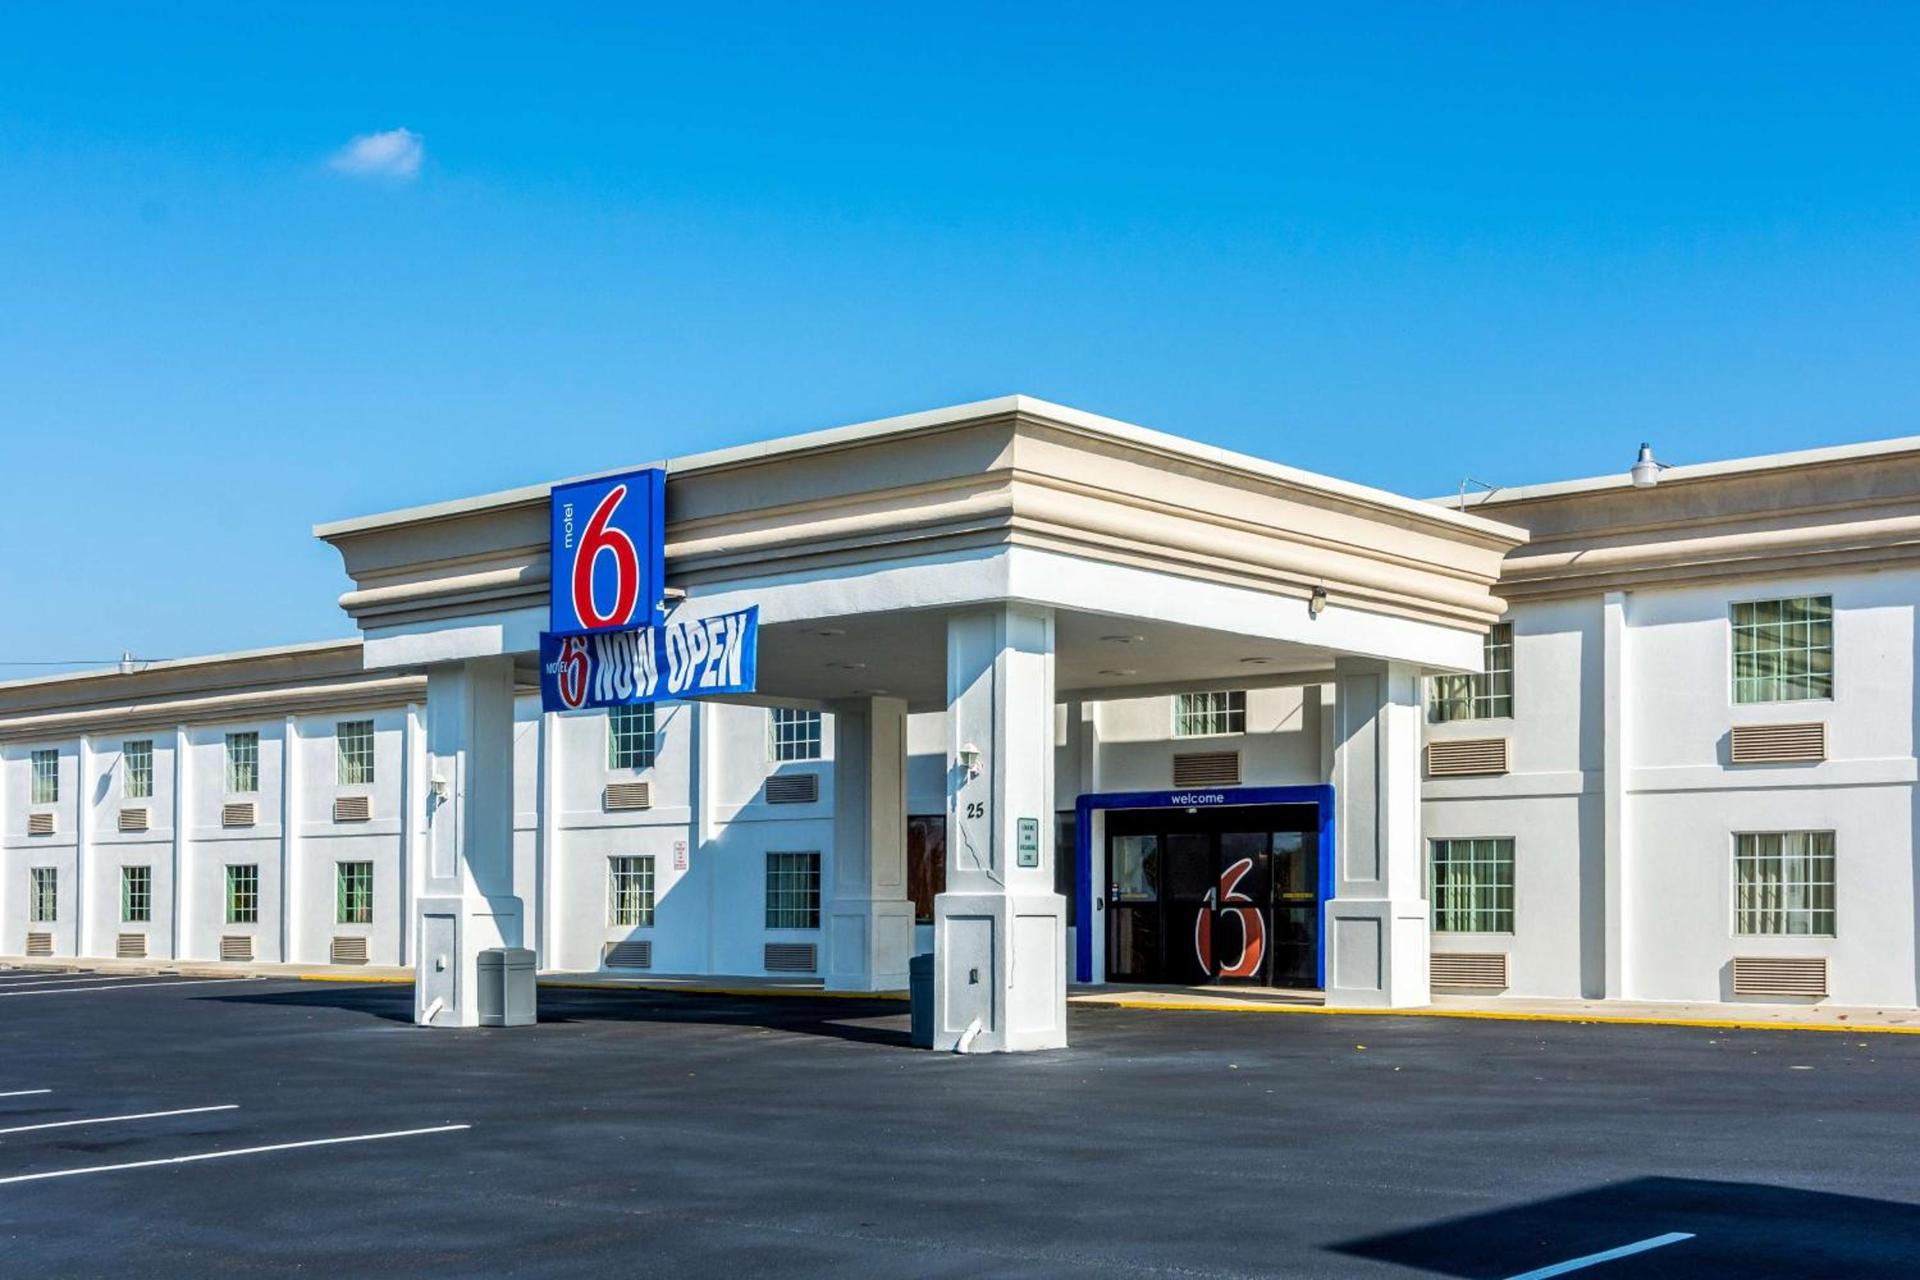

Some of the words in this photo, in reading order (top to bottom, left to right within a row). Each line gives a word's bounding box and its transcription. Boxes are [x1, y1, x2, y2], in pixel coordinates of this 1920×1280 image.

[564, 503, 573, 548] motel
[572, 484, 640, 629] 6
[546, 661, 568, 674] MOTEL
[558, 636, 592, 709] 6
[594, 627, 659, 701] NOW
[665, 614, 747, 693] OPEN
[966, 801, 985, 819] 25
[1171, 792, 1225, 805] welcome
[1195, 857, 1267, 977] 6
